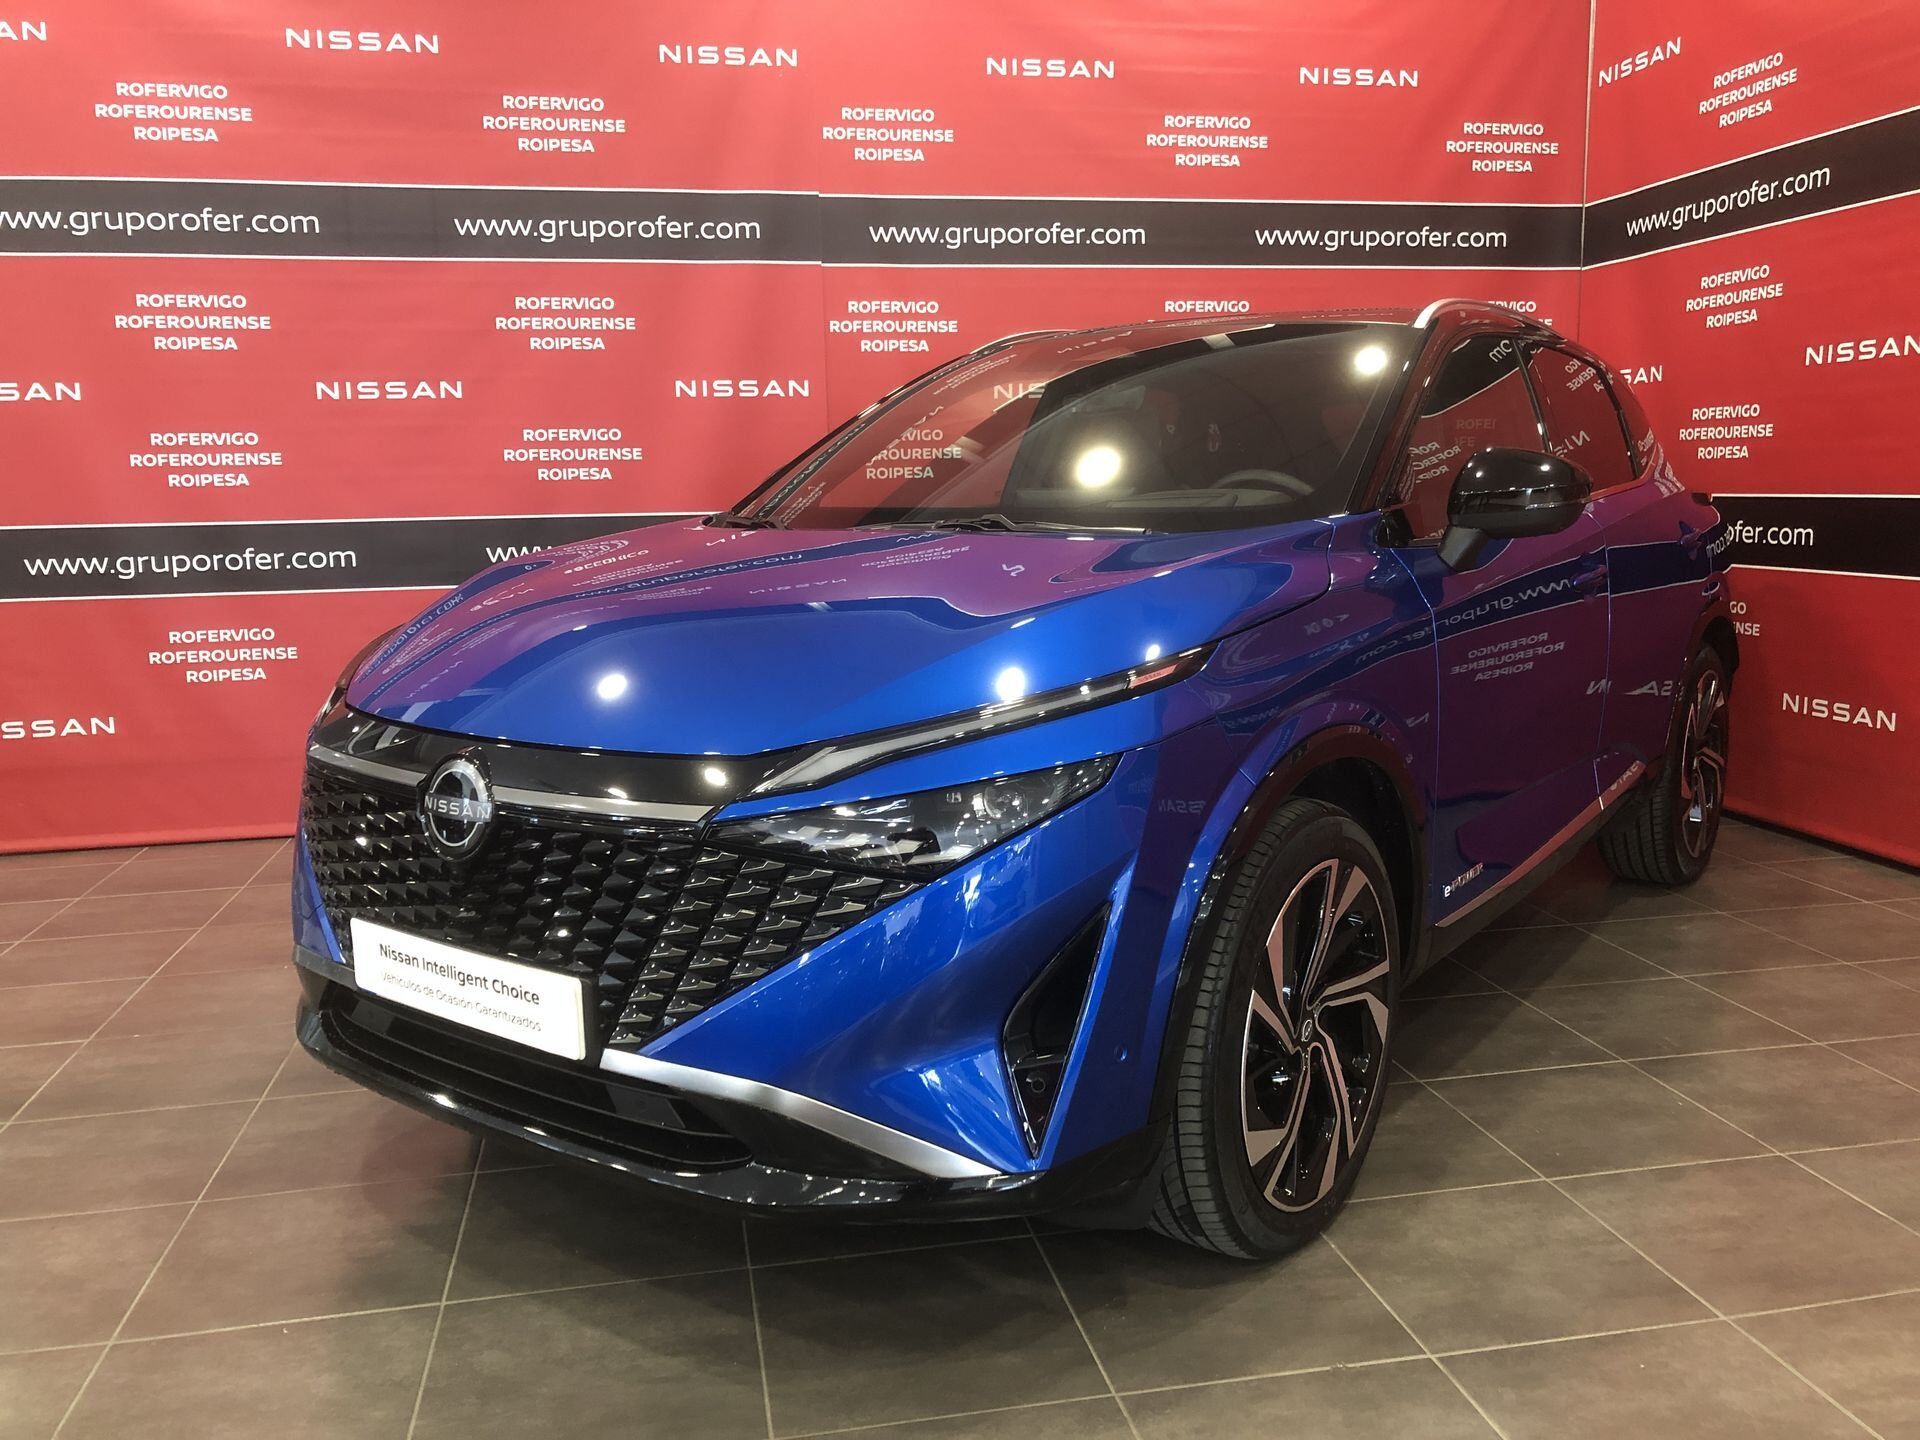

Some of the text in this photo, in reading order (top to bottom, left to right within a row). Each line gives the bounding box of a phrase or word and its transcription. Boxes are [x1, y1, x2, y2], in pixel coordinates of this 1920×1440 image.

[285, 28, 439, 54] NISSAN
[659, 44, 798, 67] NISSAN
[1598, 36, 1681, 87] NISSAN
[986, 57, 1115, 79] NISSAN
[1299, 66, 1418, 87] NISSAN
[1713, 51, 1783, 89] ROFERVIGO
[115, 82, 228, 100] ROFERVIGO
[1698, 67, 1798, 115] ROFEROURENSE
[502, 95, 605, 112] ROFERVIGO
[95, 103, 253, 122] ROFEROURENSE
[841, 107, 935, 123] ROFERVIGO
[1718, 99, 1773, 128] ROIPESA
[482, 115, 626, 133] ROFEROURENSE
[1164, 115, 1251, 130] ROFERVIGO
[1463, 122, 1544, 136] ROFERVIGO
[133, 126, 219, 142] ROIPESA
[822, 126, 954, 143] ROFEROURENSE
[1146, 134, 1268, 149] ROFEROURENSE
[518, 137, 595, 153] ROIPESA
[1446, 140, 1559, 155] ROFEROURENSE
[854, 147, 925, 162] ROIPESA
[1175, 153, 1240, 167] ROIPESA
[1472, 159, 1533, 173] ROIPESA
[1626, 166, 1831, 237] www.gruporofer.com
[0, 207, 320, 236] ww.gruporofer.com
[453, 215, 761, 243] www.gruporofer.com
[868, 222, 1146, 250] www.gruporofer.com
[1254, 226, 1507, 252] www.gruporofer.com
[1700, 264, 1770, 290] ROFERVIGO
[135, 293, 247, 309] ROFERVIGO
[515, 296, 615, 311] ROFERVIGO
[1685, 283, 1784, 312] ROFEROURENSE
[847, 300, 939, 314] ROFERVIGO
[1164, 300, 1250, 313] ROFERVIGO
[114, 315, 271, 330] ROFEROURENSE
[495, 316, 636, 330] ROFEROURENSE
[829, 319, 958, 333] ROFEROURENSE
[1705, 308, 1758, 328] ROIPESA
[153, 336, 238, 351] ROIPESA
[529, 336, 606, 350] ROIPESA
[860, 339, 929, 352] ROIPESA
[0, 382, 81, 402] SAN
[315, 380, 463, 400] NISSAN
[675, 379, 809, 398] NISSAN
[1692, 403, 1761, 421] ROFERVIGO
[150, 432, 259, 446] ROFERVIGO
[522, 428, 622, 442] ROFERVIGO
[1679, 424, 1774, 441] ROFEROURENSE
[129, 452, 283, 467] ROFEROURENSE
[503, 447, 643, 462] ROFEROURENSE
[1697, 445, 1749, 460] ROIPESA
[167, 473, 250, 487] ROIPESA
[537, 467, 613, 481] ROIPESA
[866, 466, 934, 480] ROIPESA
[23, 547, 357, 580] www.gruporofer.com
[168, 627, 275, 644] ROFERVIGO
[148, 646, 298, 665] ROFEROURENSE
[186, 667, 267, 683] ROIPESA
[1782, 692, 1897, 732] NISSAN
[0, 716, 116, 739] SSAN
[424, 795, 491, 820] NISSAN
[379, 943, 540, 1005] Nissan Intelligent Choice
[423, 985, 434, 998] de
[475, 1001, 542, 1032] Garantizados
